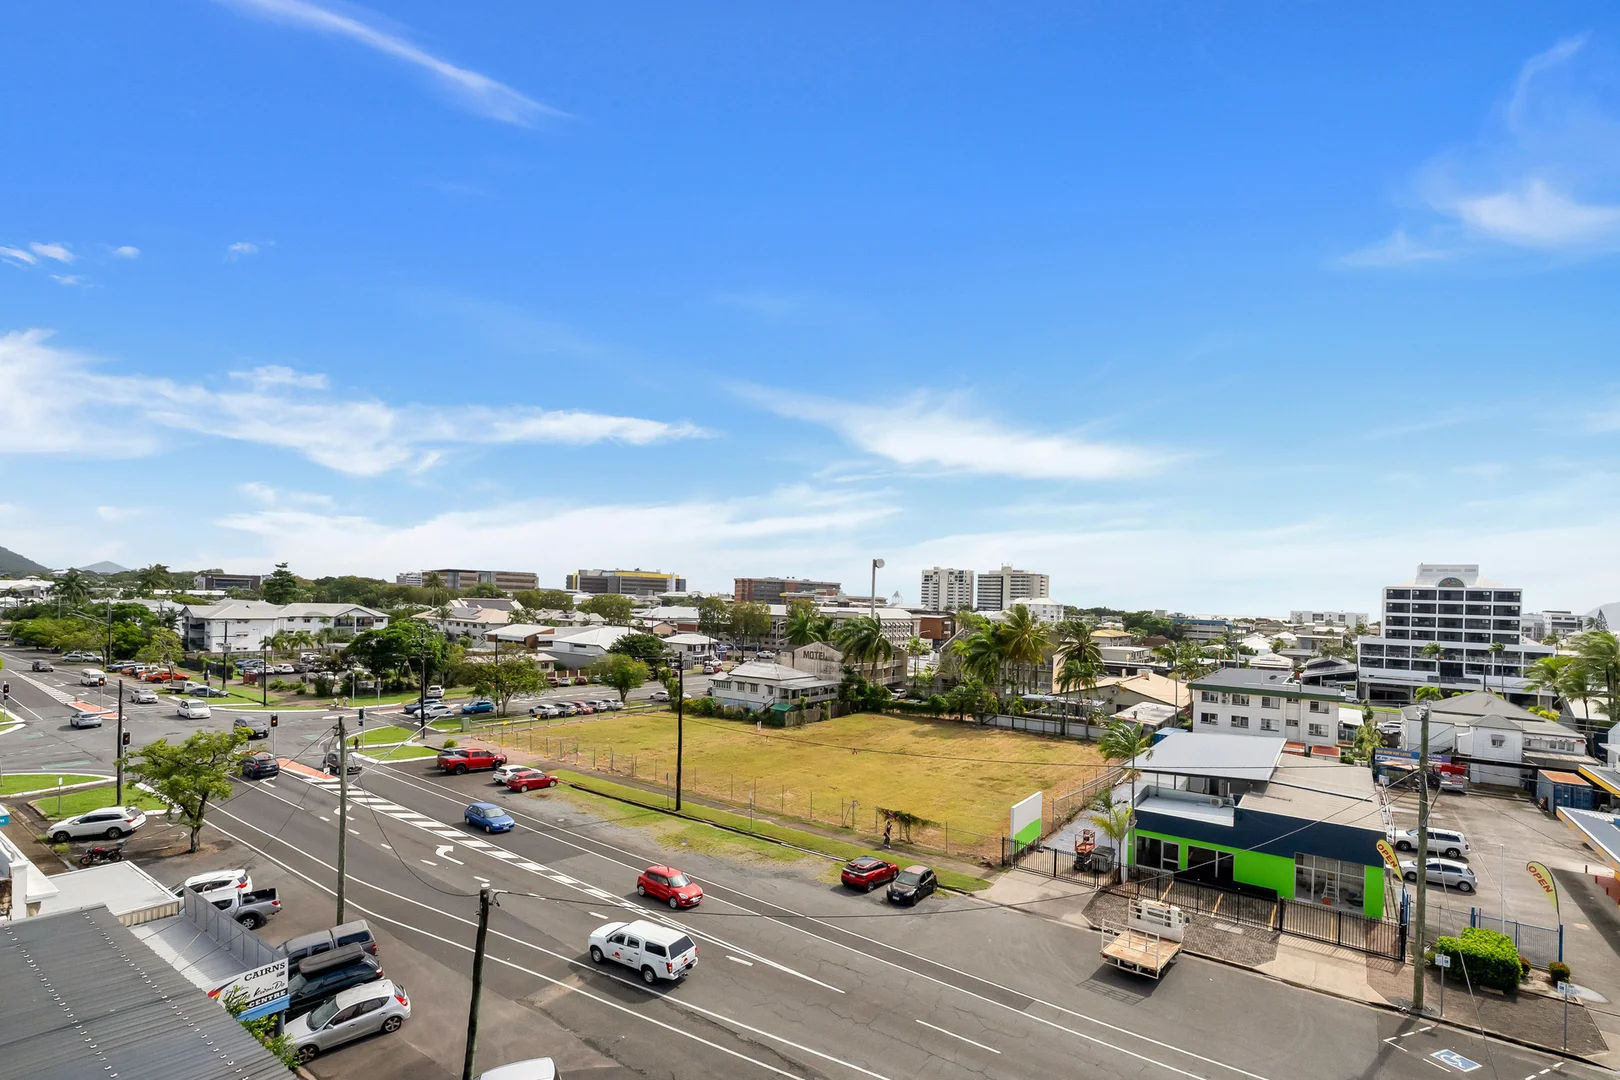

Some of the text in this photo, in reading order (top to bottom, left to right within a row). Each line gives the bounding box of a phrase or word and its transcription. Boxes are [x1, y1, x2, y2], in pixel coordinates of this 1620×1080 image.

[803, 650, 827, 660] MOTEL
[1377, 843, 1398, 868] OPEN
[1528, 865, 1553, 893] OPEN
[244, 962, 285, 981] CAIRNS
[248, 990, 286, 1008] CENTRE
